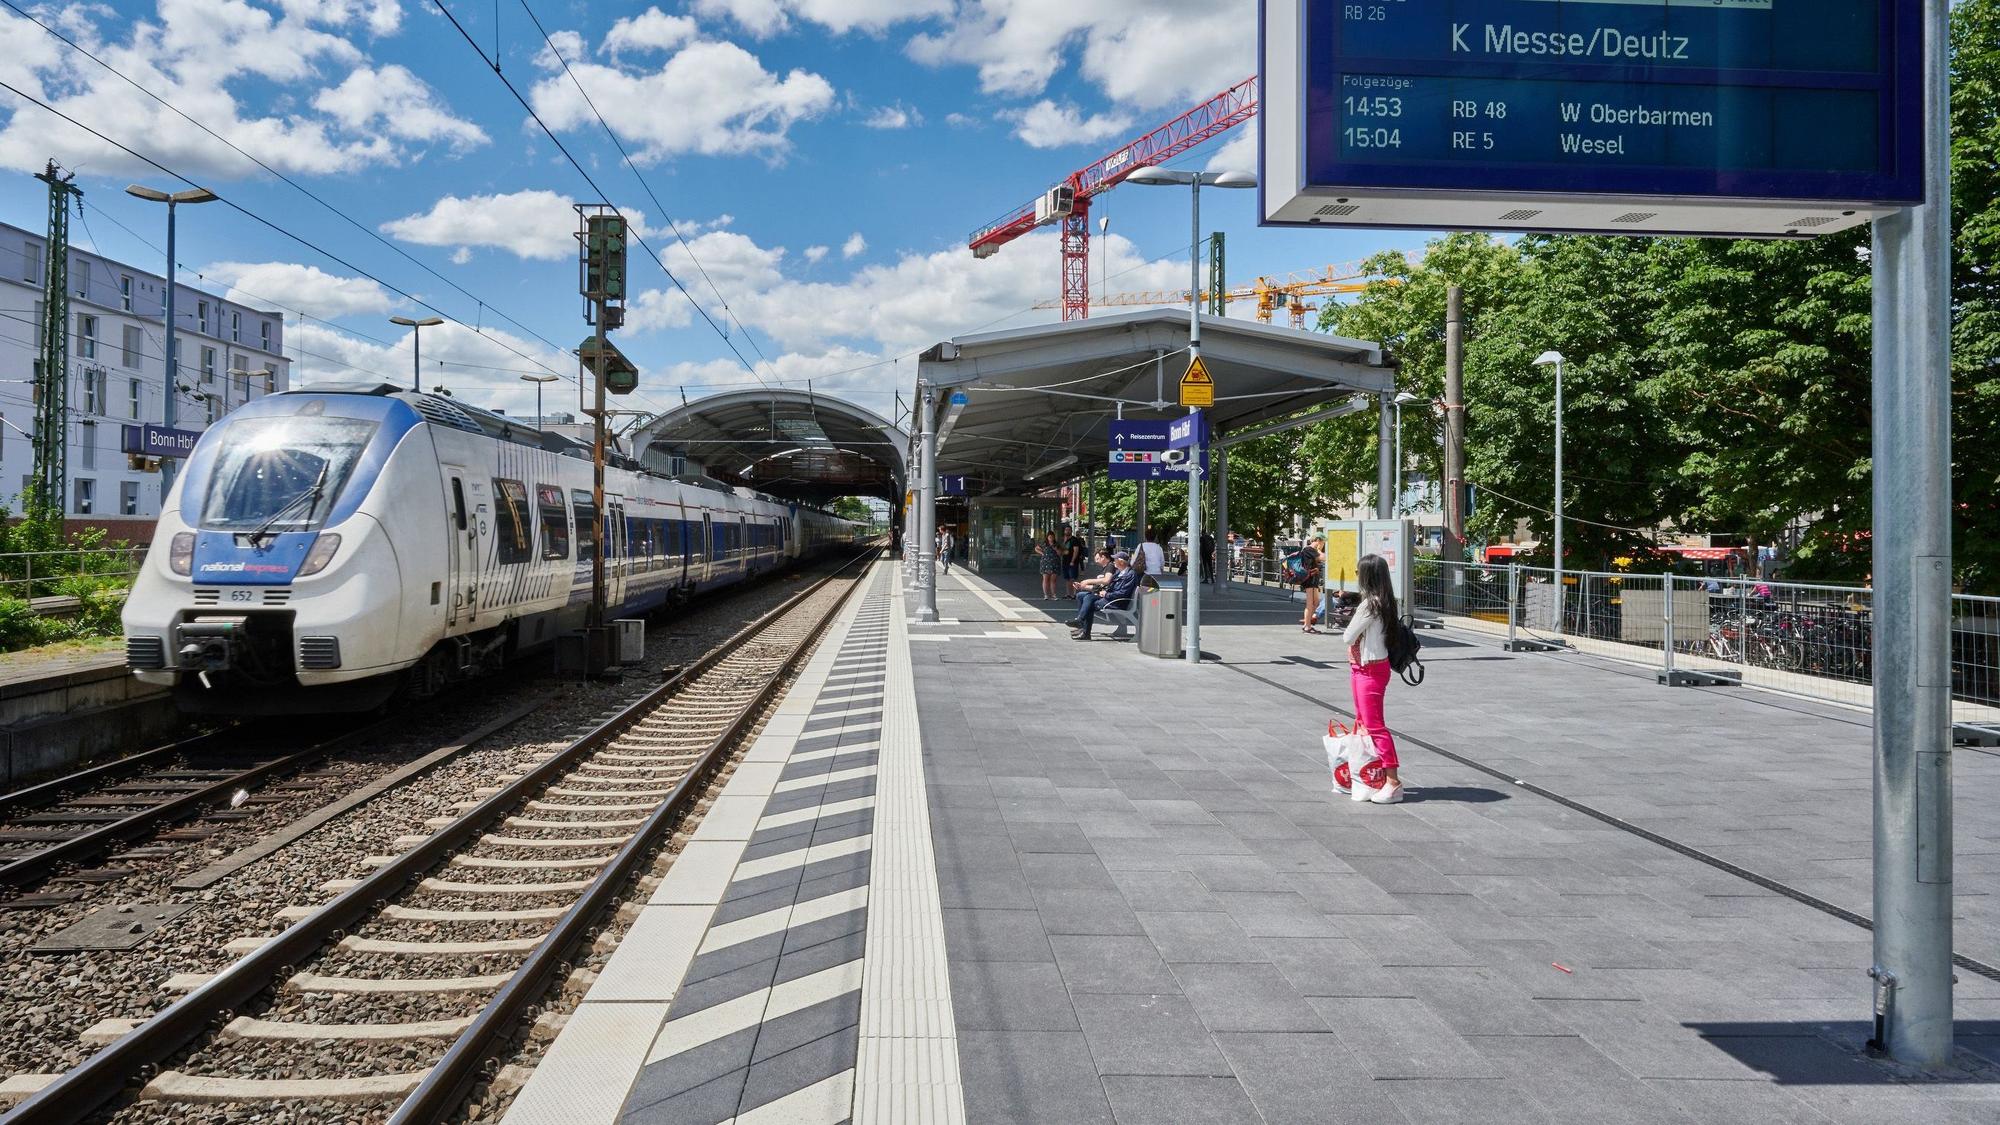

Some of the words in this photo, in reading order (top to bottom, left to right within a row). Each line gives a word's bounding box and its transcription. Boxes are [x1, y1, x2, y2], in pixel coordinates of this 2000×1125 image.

[1345, 5, 1363, 20] RB
[1368, 6, 1386, 21] 26
[1452, 23, 1471, 52] K
[1485, 24, 1689, 60] Messe/Deutz
[1343, 75, 1414, 90] Folgezüge:
[1344, 96, 1402, 117] 14:53
[1453, 100, 1477, 118] RB
[1485, 101, 1506, 119] 48
[1561, 102, 1581, 122] W
[1590, 103, 1713, 126] Oberbarmen
[1344, 127, 1402, 148] 15:04
[1453, 131, 1476, 149] RE
[1483, 132, 1495, 150] 5
[1561, 133, 1625, 155] Wesel
[150, 430, 175, 448] Bonn
[177, 434, 194, 449] Hbf
[231, 590, 252, 602] 652
